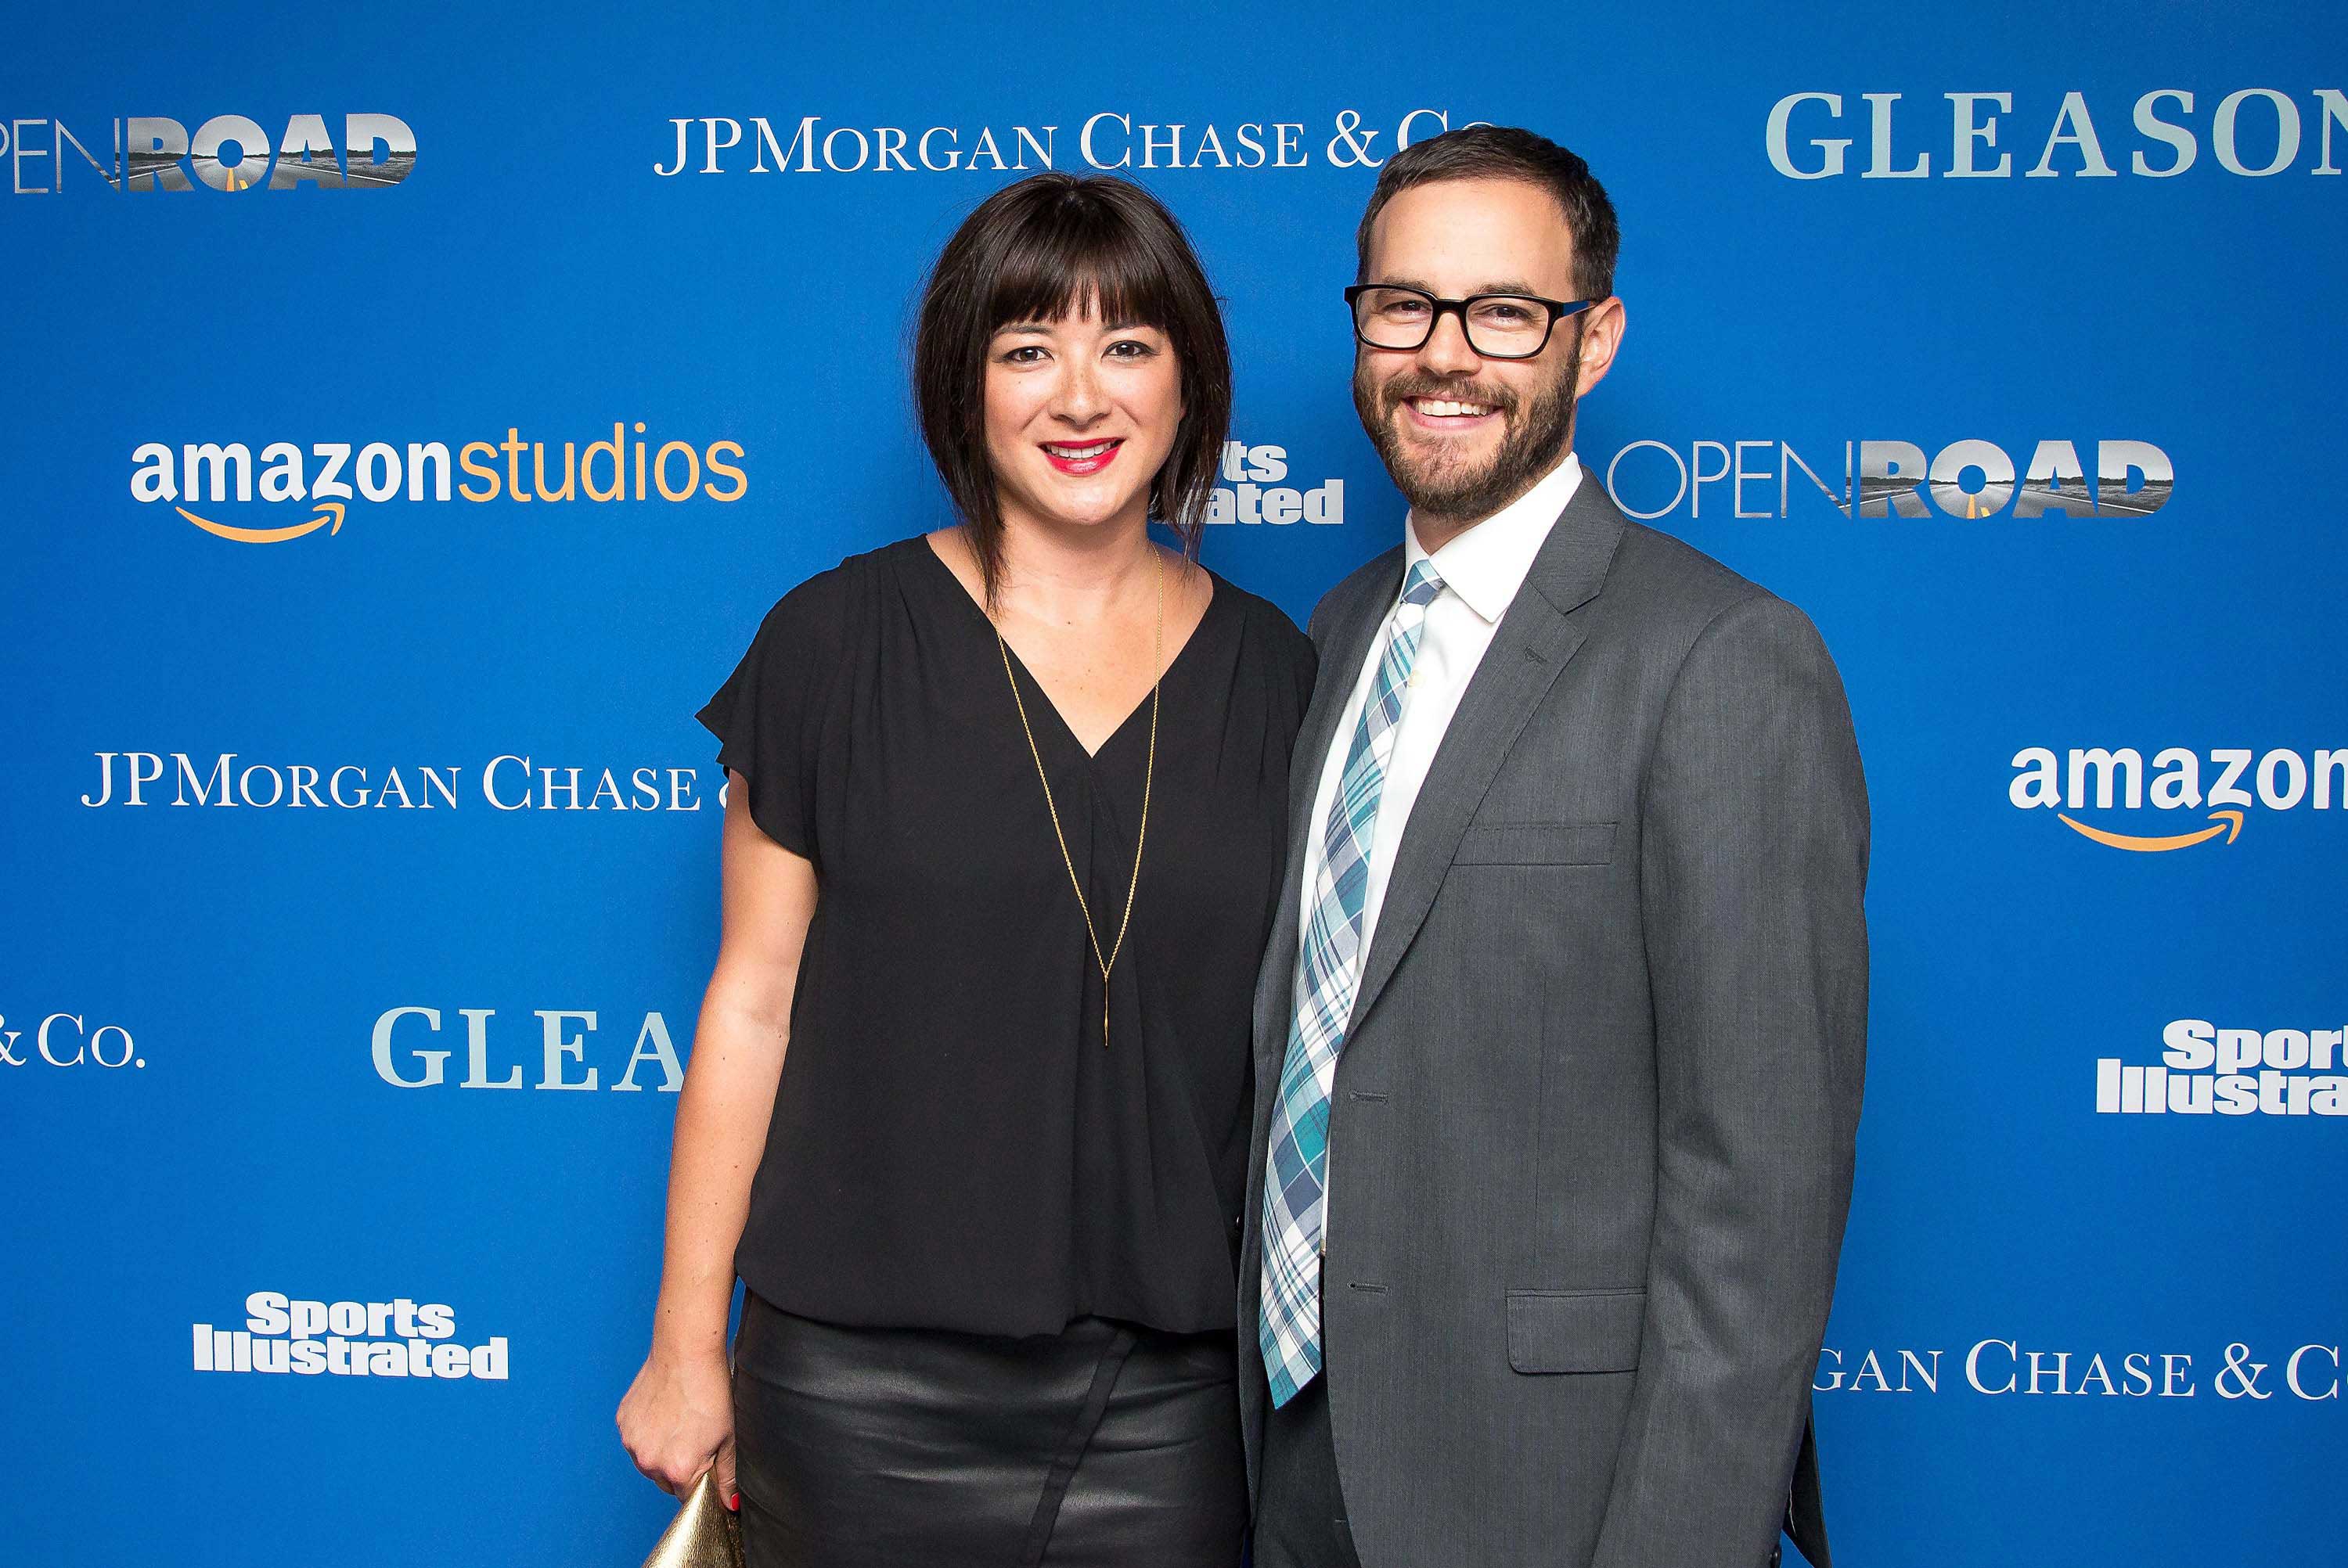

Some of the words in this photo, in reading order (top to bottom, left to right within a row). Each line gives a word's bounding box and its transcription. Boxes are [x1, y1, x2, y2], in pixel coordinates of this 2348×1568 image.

[0, 113, 417, 194] ENROAD
[1079, 112, 1309, 170] CHASE
[1327, 110, 1385, 168] &
[1396, 109, 1496, 153] C
[482, 754, 700, 811] CHASE
[2008, 746, 2348, 811] amazon
[371, 1006, 684, 1092] GLEA
[2162, 1019, 2348, 1074] Spor
[245, 1291, 456, 1340] Sports
[193, 1323, 509, 1380] Illustrated
[1965, 1339, 2195, 1397] CHASE
[2214, 1343, 2273, 1400] &
[2286, 1344, 2348, 1401] C
